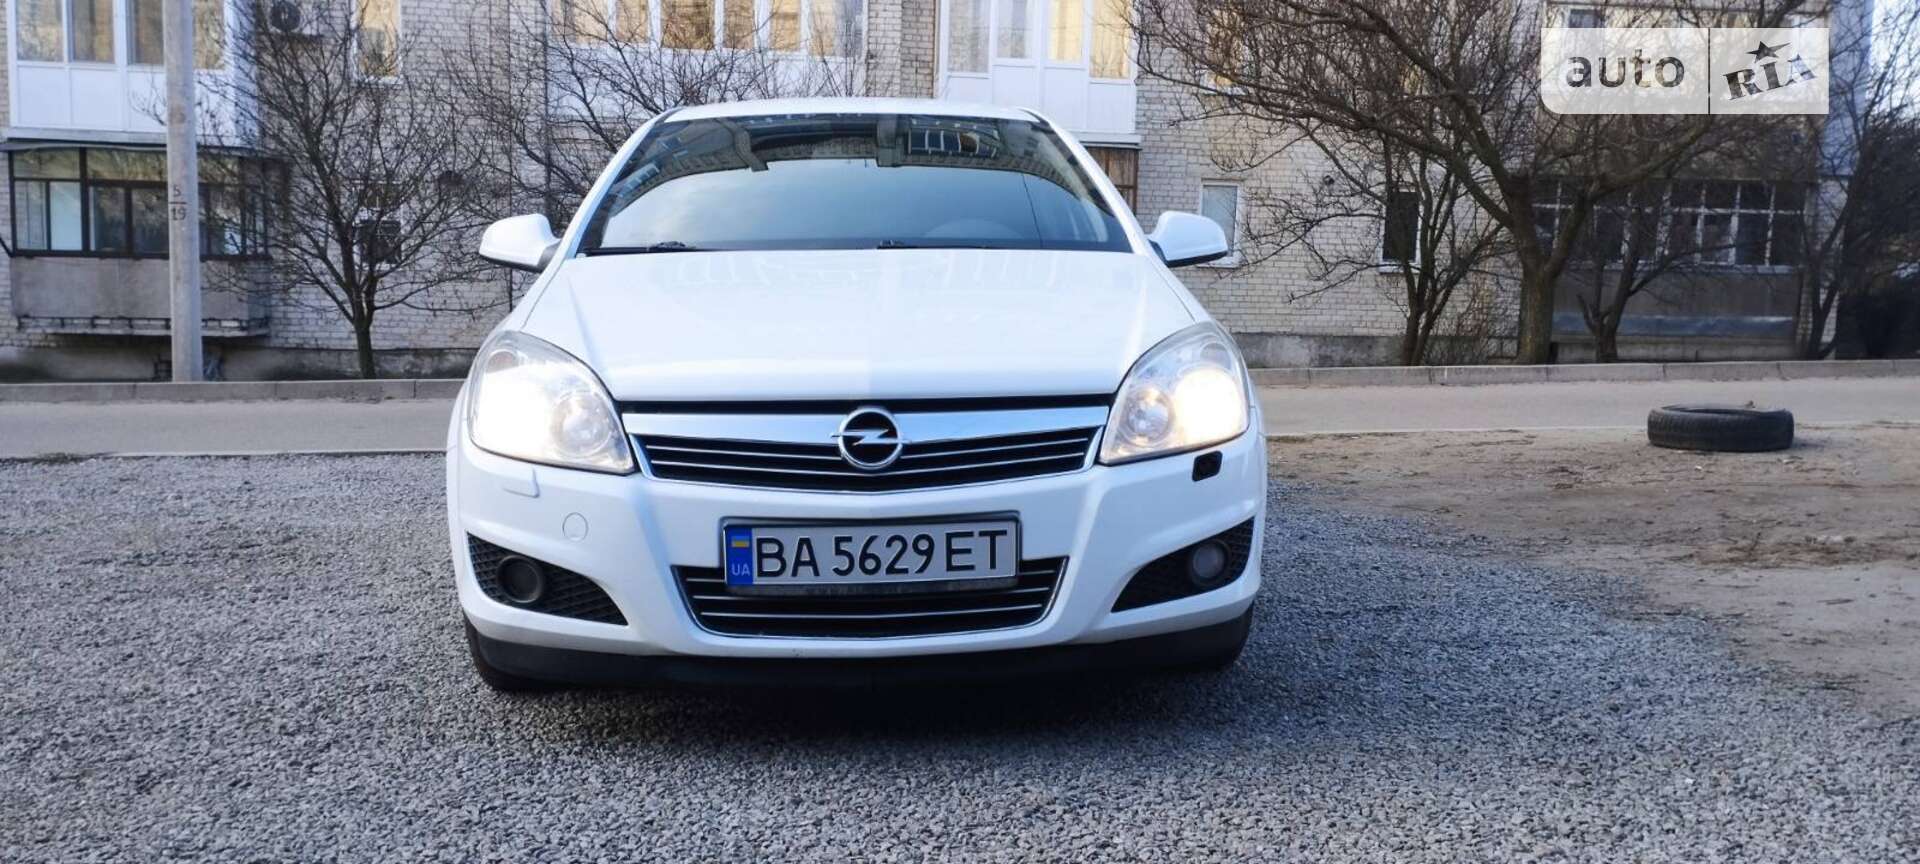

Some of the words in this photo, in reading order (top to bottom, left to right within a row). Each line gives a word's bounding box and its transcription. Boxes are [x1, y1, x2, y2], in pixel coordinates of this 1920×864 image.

[173, 184, 182, 198] 5
[756, 536, 821, 578] BA
[832, 534, 936, 577] 5629
[945, 529, 1008, 572] ET
[731, 563, 750, 577] UA
